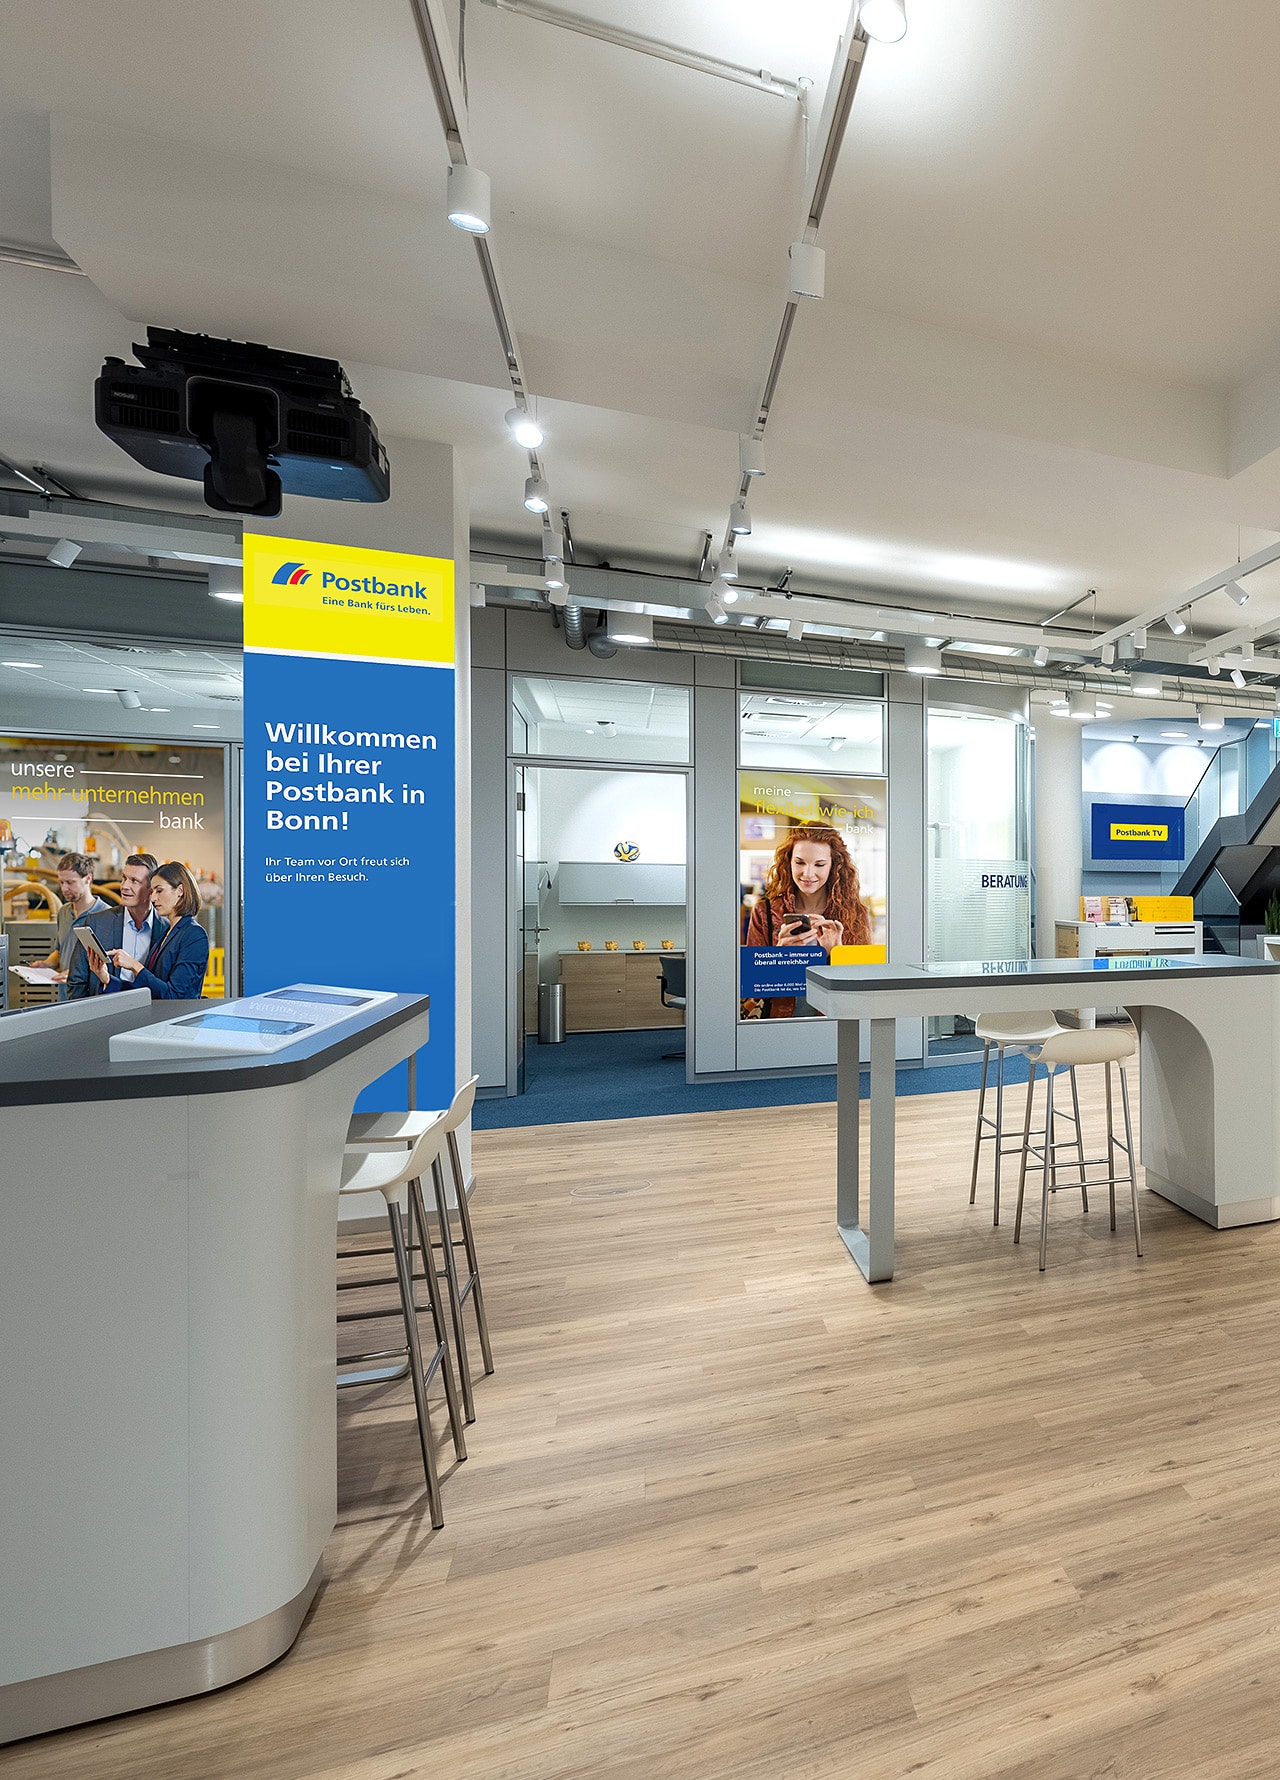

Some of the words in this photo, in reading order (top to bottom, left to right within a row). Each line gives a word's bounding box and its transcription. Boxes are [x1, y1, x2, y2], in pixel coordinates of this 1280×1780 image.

[322, 571, 428, 600] Postbank
[322, 596, 345, 607] Eine
[347, 599, 373, 610] Bank
[375, 602, 395, 612] fürs
[397, 604, 431, 616] Leben.
[264, 722, 437, 750] Willkommen
[11, 762, 75, 778] unsere
[266, 750, 309, 773] bei
[318, 752, 382, 775] Ihrer
[11, 781, 205, 807] mehr-unternehmen
[266, 780, 394, 804] Postbank
[402, 783, 425, 804] in
[753, 785, 791, 797] meine
[755, 799, 875, 819] flexibel-wie-ich
[159, 811, 205, 831] bank
[266, 809, 349, 831] Bonn!
[846, 823, 874, 835] bank
[1116, 828, 1150, 837] Postbank
[1153, 829, 1163, 837] TV
[265, 857, 281, 866] Ihr
[284, 857, 315, 867] Team
[317, 858, 336, 866] vor
[339, 857, 358, 866] Ort
[360, 856, 387, 866] freut
[390, 857, 410, 866] sich
[265, 872, 292, 882] über
[295, 873, 324, 882] Ihren
[328, 872, 369, 882] Besuch.
[982, 874, 1028, 889] BERATUNG
